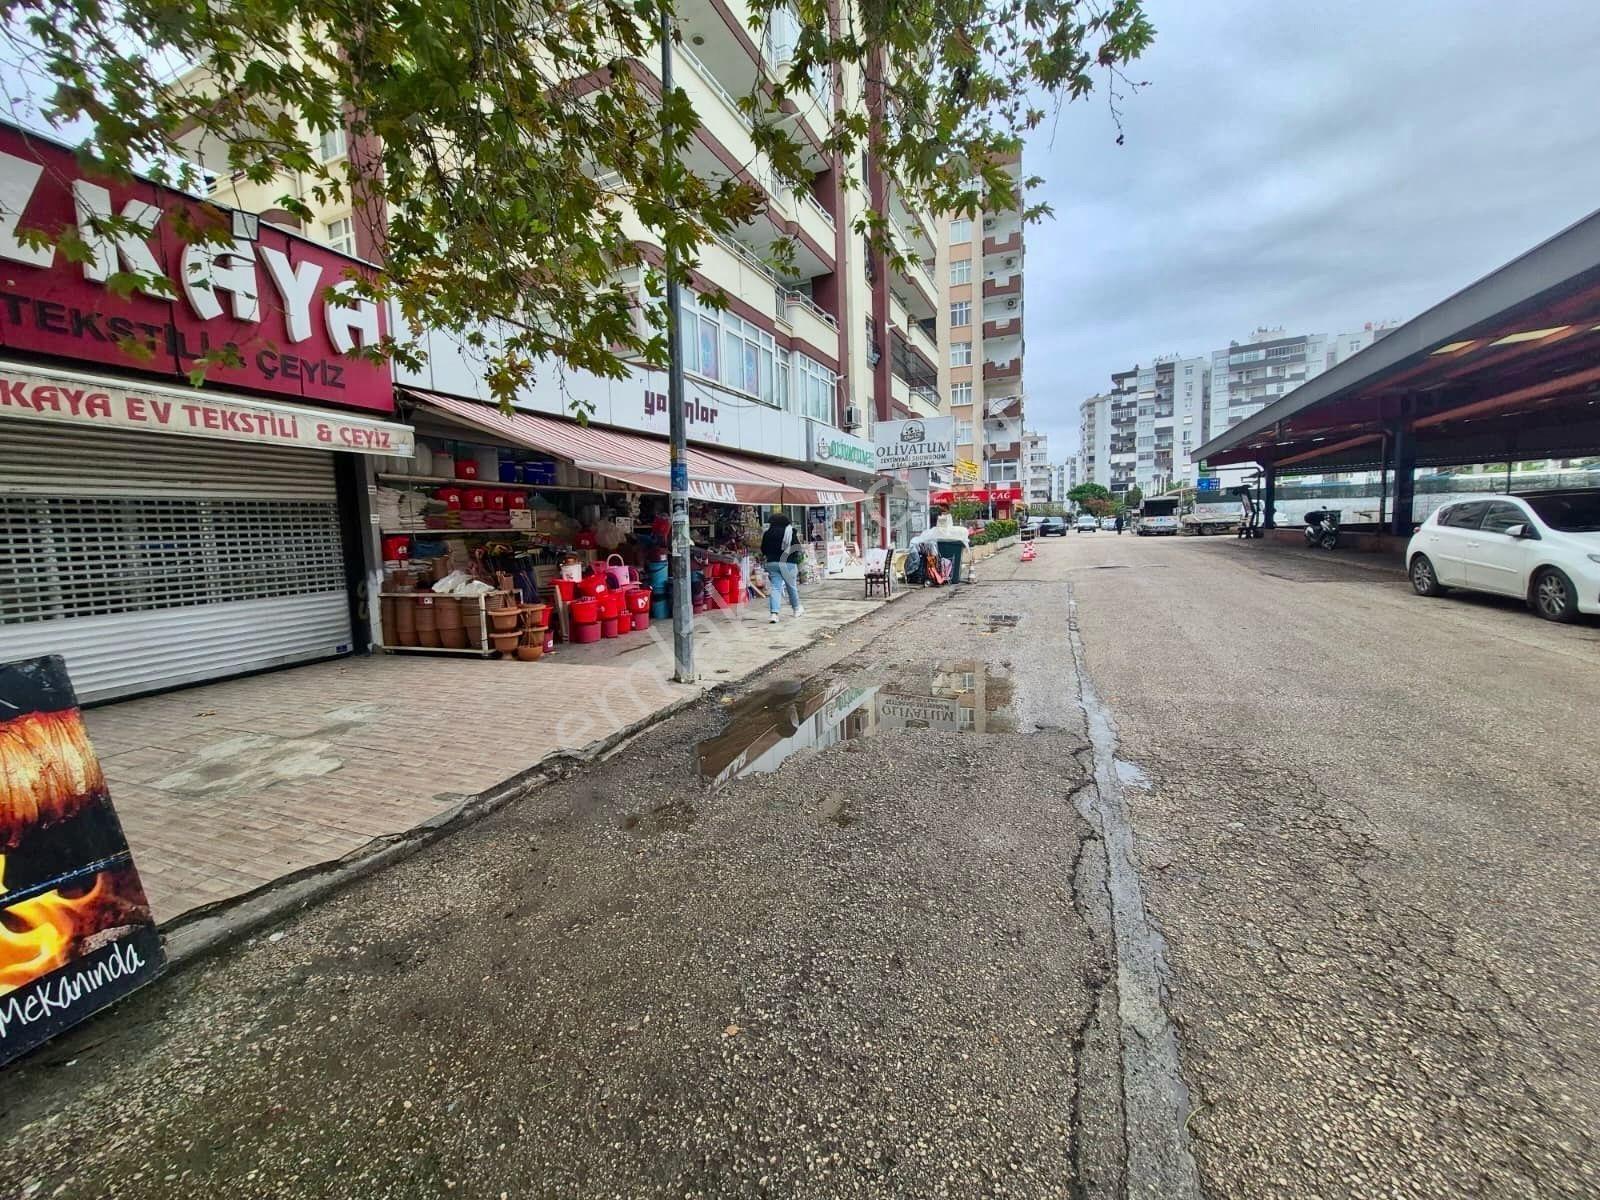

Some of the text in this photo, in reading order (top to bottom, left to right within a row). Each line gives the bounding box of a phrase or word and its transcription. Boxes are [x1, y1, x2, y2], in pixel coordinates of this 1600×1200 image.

[0, 379, 391, 449] KAYA EV TEKSTİLİ & ÇEYİZ
[876, 441, 951, 457] OLİVATUM
